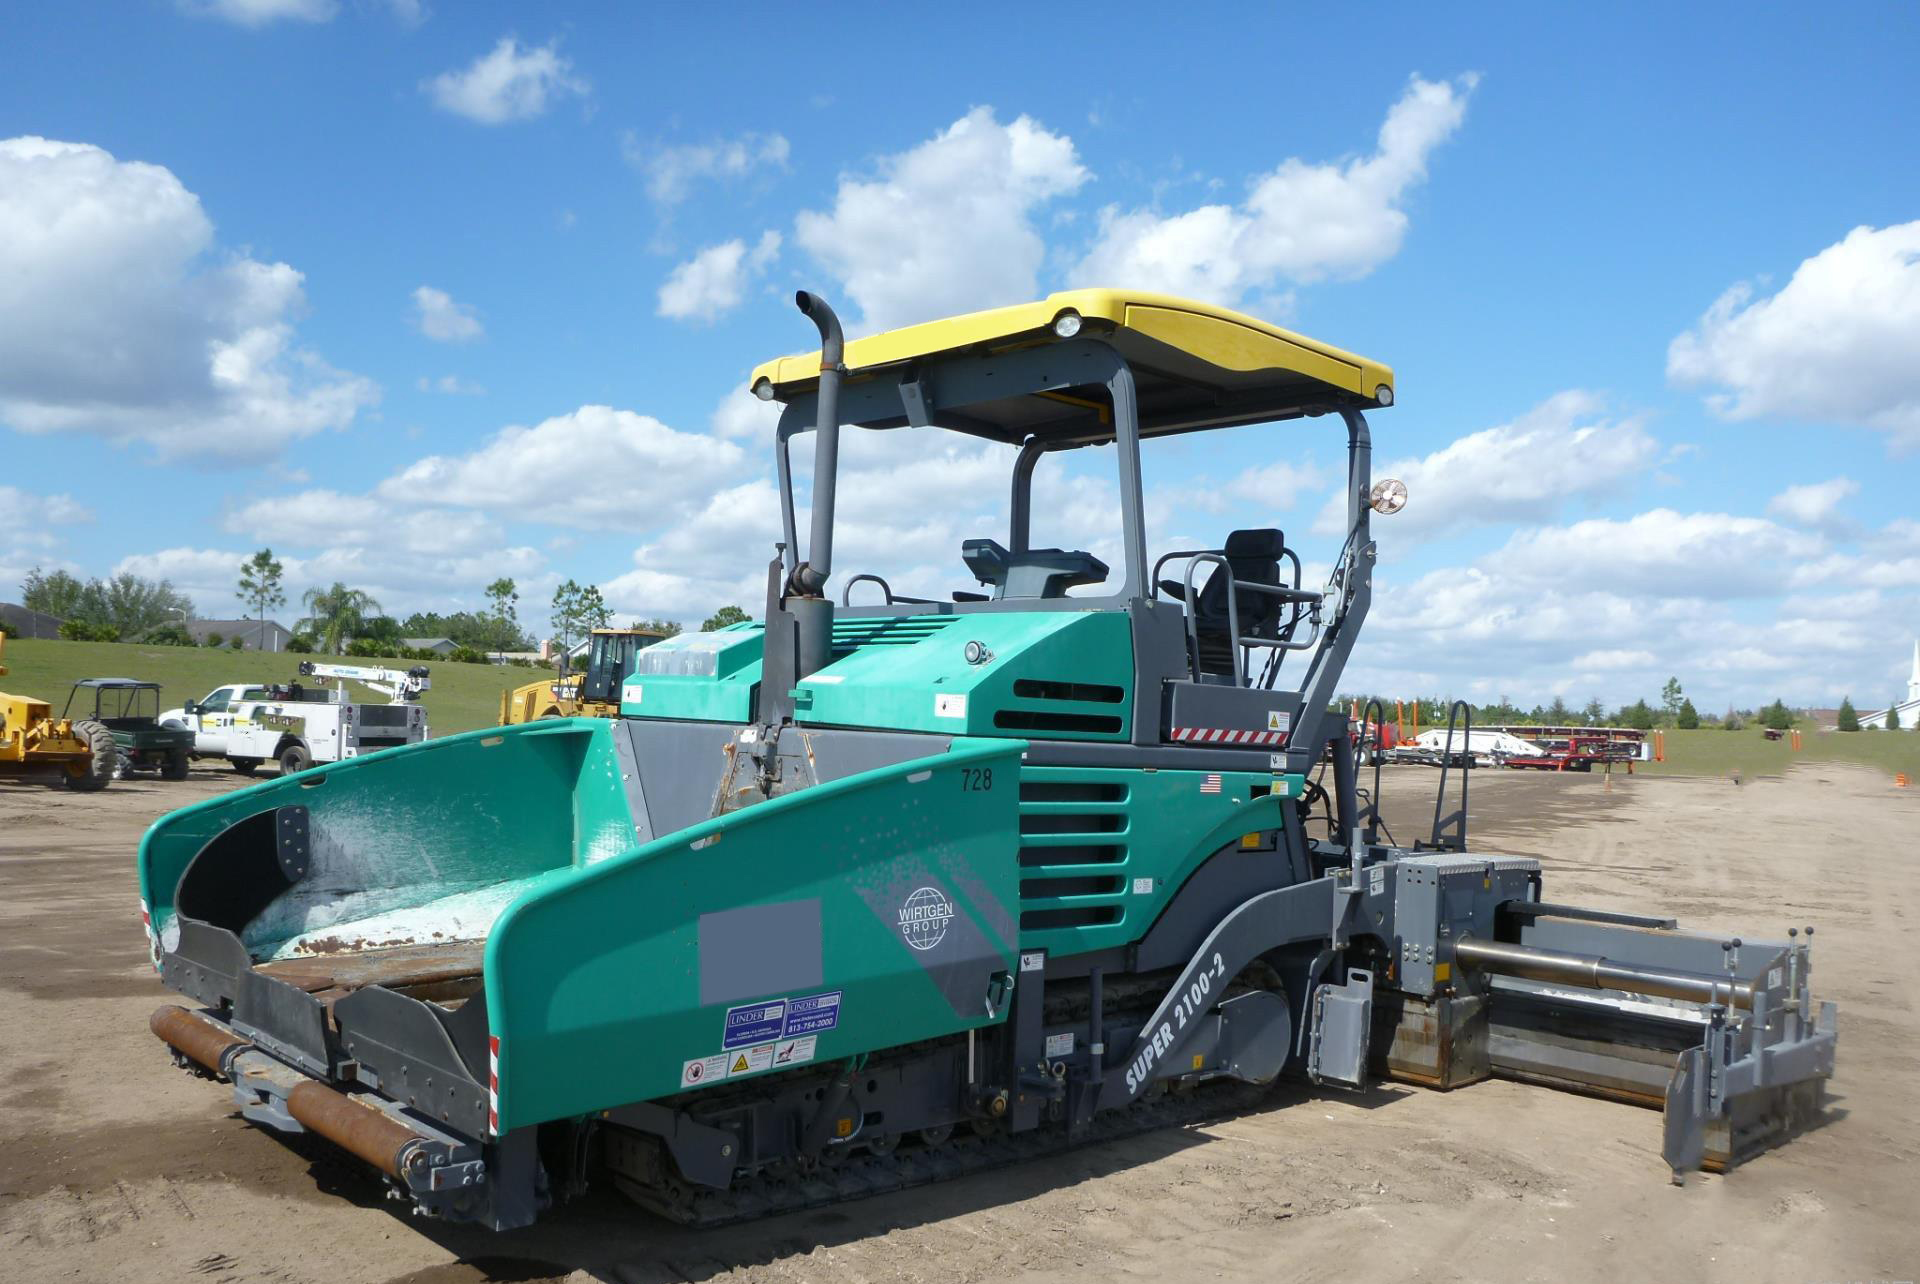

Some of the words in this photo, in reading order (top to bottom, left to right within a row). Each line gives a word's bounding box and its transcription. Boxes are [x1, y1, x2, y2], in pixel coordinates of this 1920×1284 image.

[961, 767, 993, 792] 728
[898, 902, 953, 922] WIRTGEN
[902, 918, 949, 935] GROUP
[790, 999, 818, 1013] LINDER
[731, 1010, 764, 1025] LINDER
[788, 1017, 833, 1033] 813-754-2000
[1126, 1022, 1175, 1095] SUPER
[1174, 952, 1225, 1030] 2100-2
